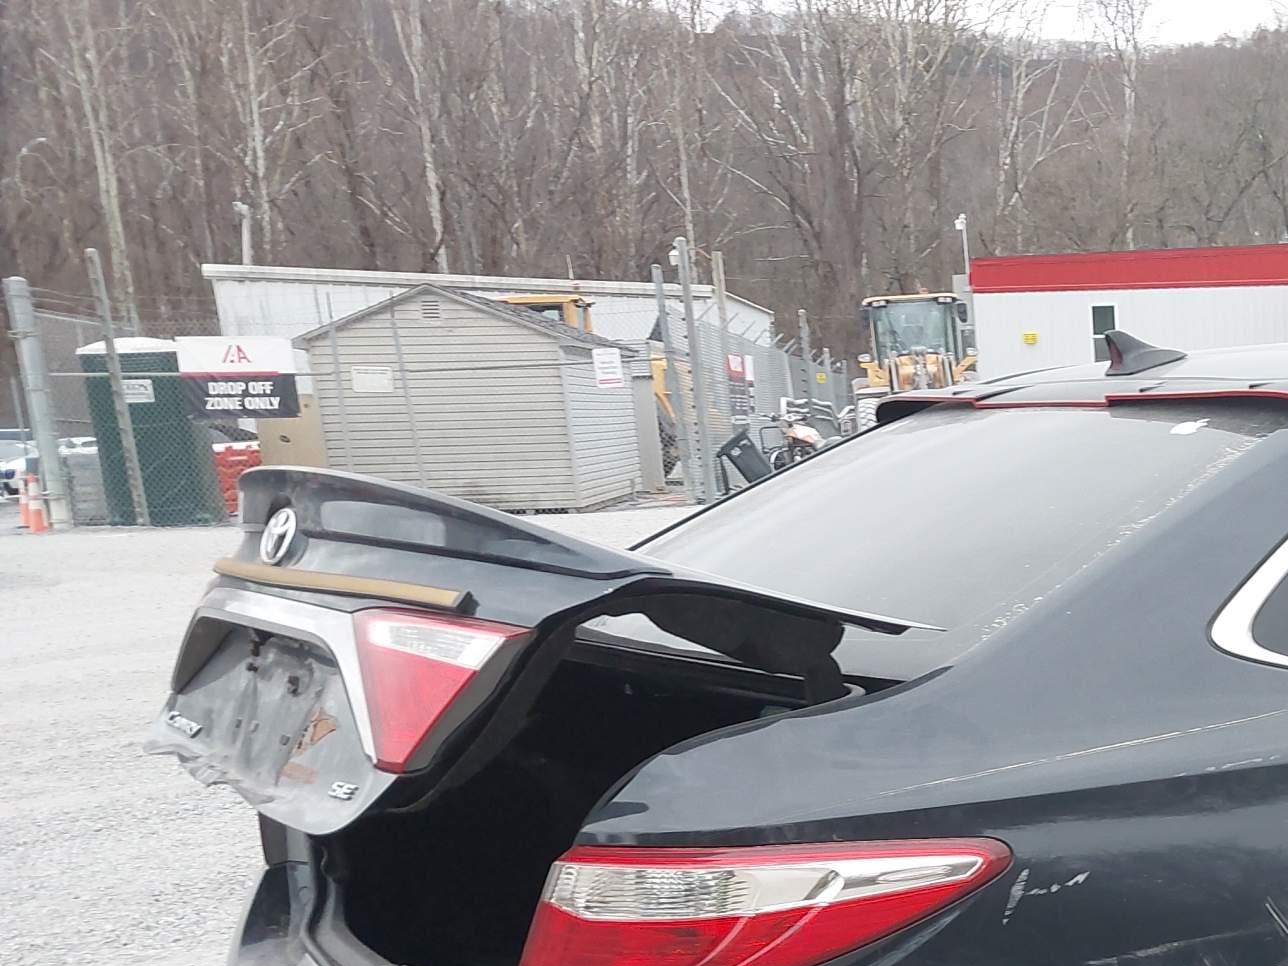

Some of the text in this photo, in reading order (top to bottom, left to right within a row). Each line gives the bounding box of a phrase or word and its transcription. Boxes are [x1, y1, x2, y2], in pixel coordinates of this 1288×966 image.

[207, 381, 274, 394] DROP OFF
[205, 397, 280, 410] ZONE ONLY
[328, 781, 358, 800] SE
